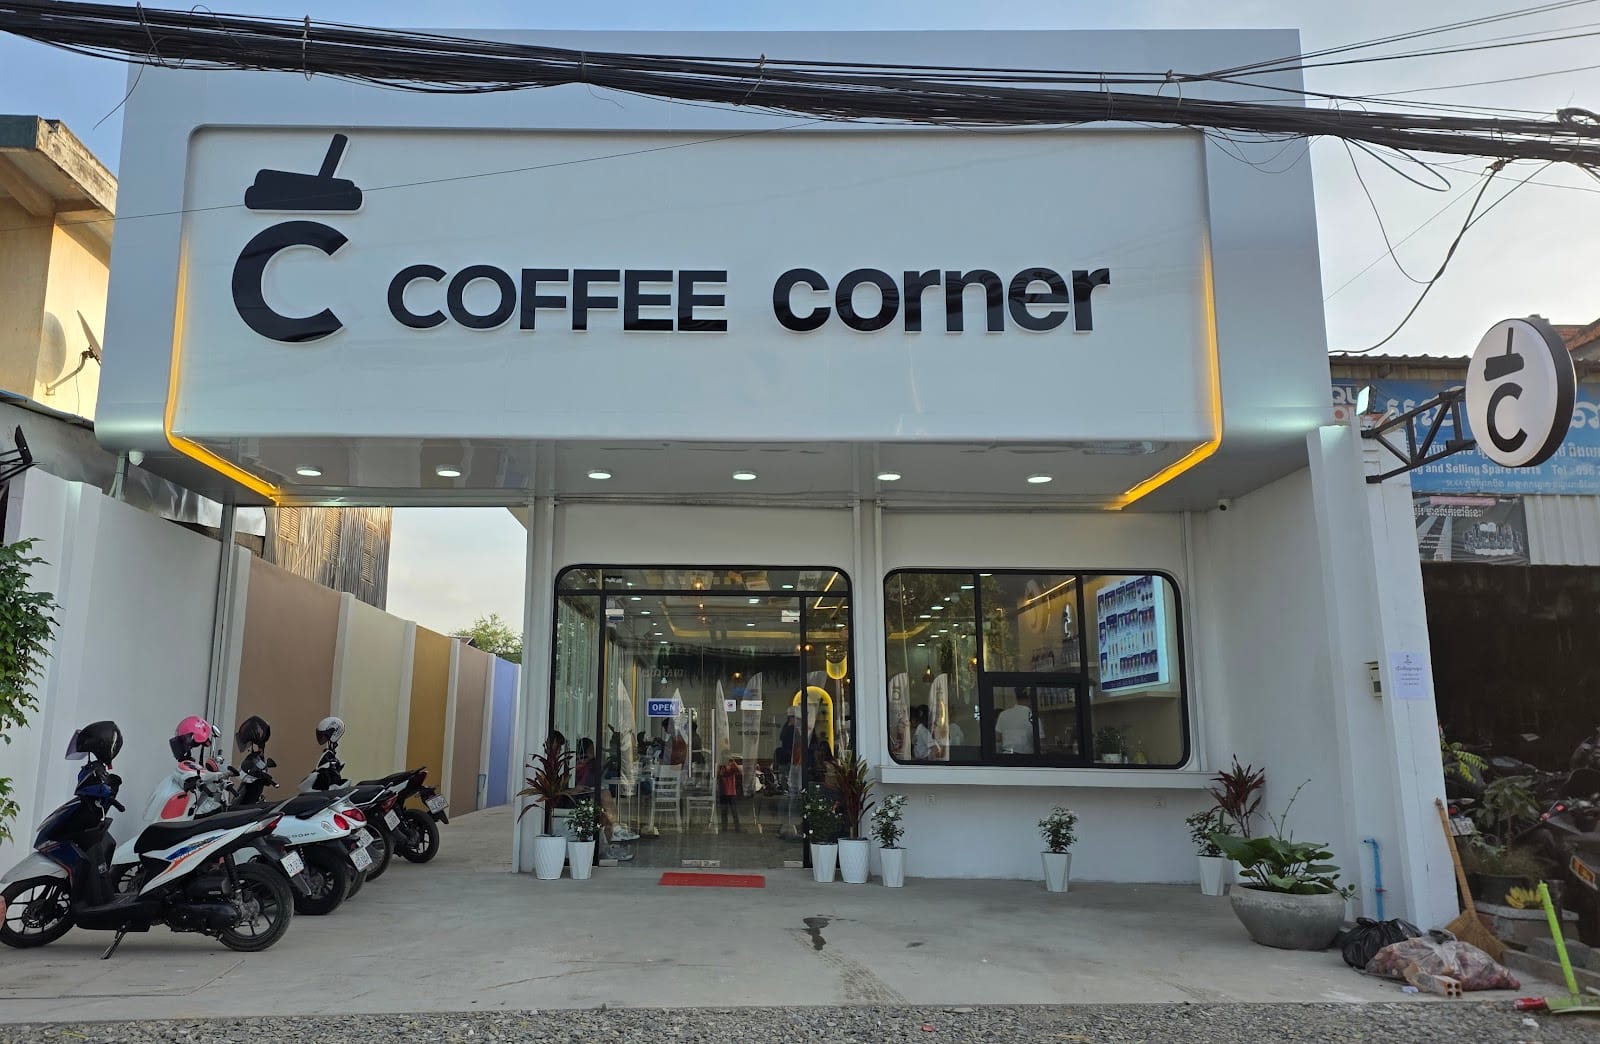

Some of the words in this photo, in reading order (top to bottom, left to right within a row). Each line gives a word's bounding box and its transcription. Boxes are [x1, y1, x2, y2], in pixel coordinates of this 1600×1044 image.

[386, 263, 729, 332] COFFEE
[771, 266, 1111, 333] corner
[1425, 464, 1444, 474] and
[1445, 463, 1480, 476] Selling
[1481, 464, 1511, 476] Spare
[652, 703, 676, 712] OPEN
